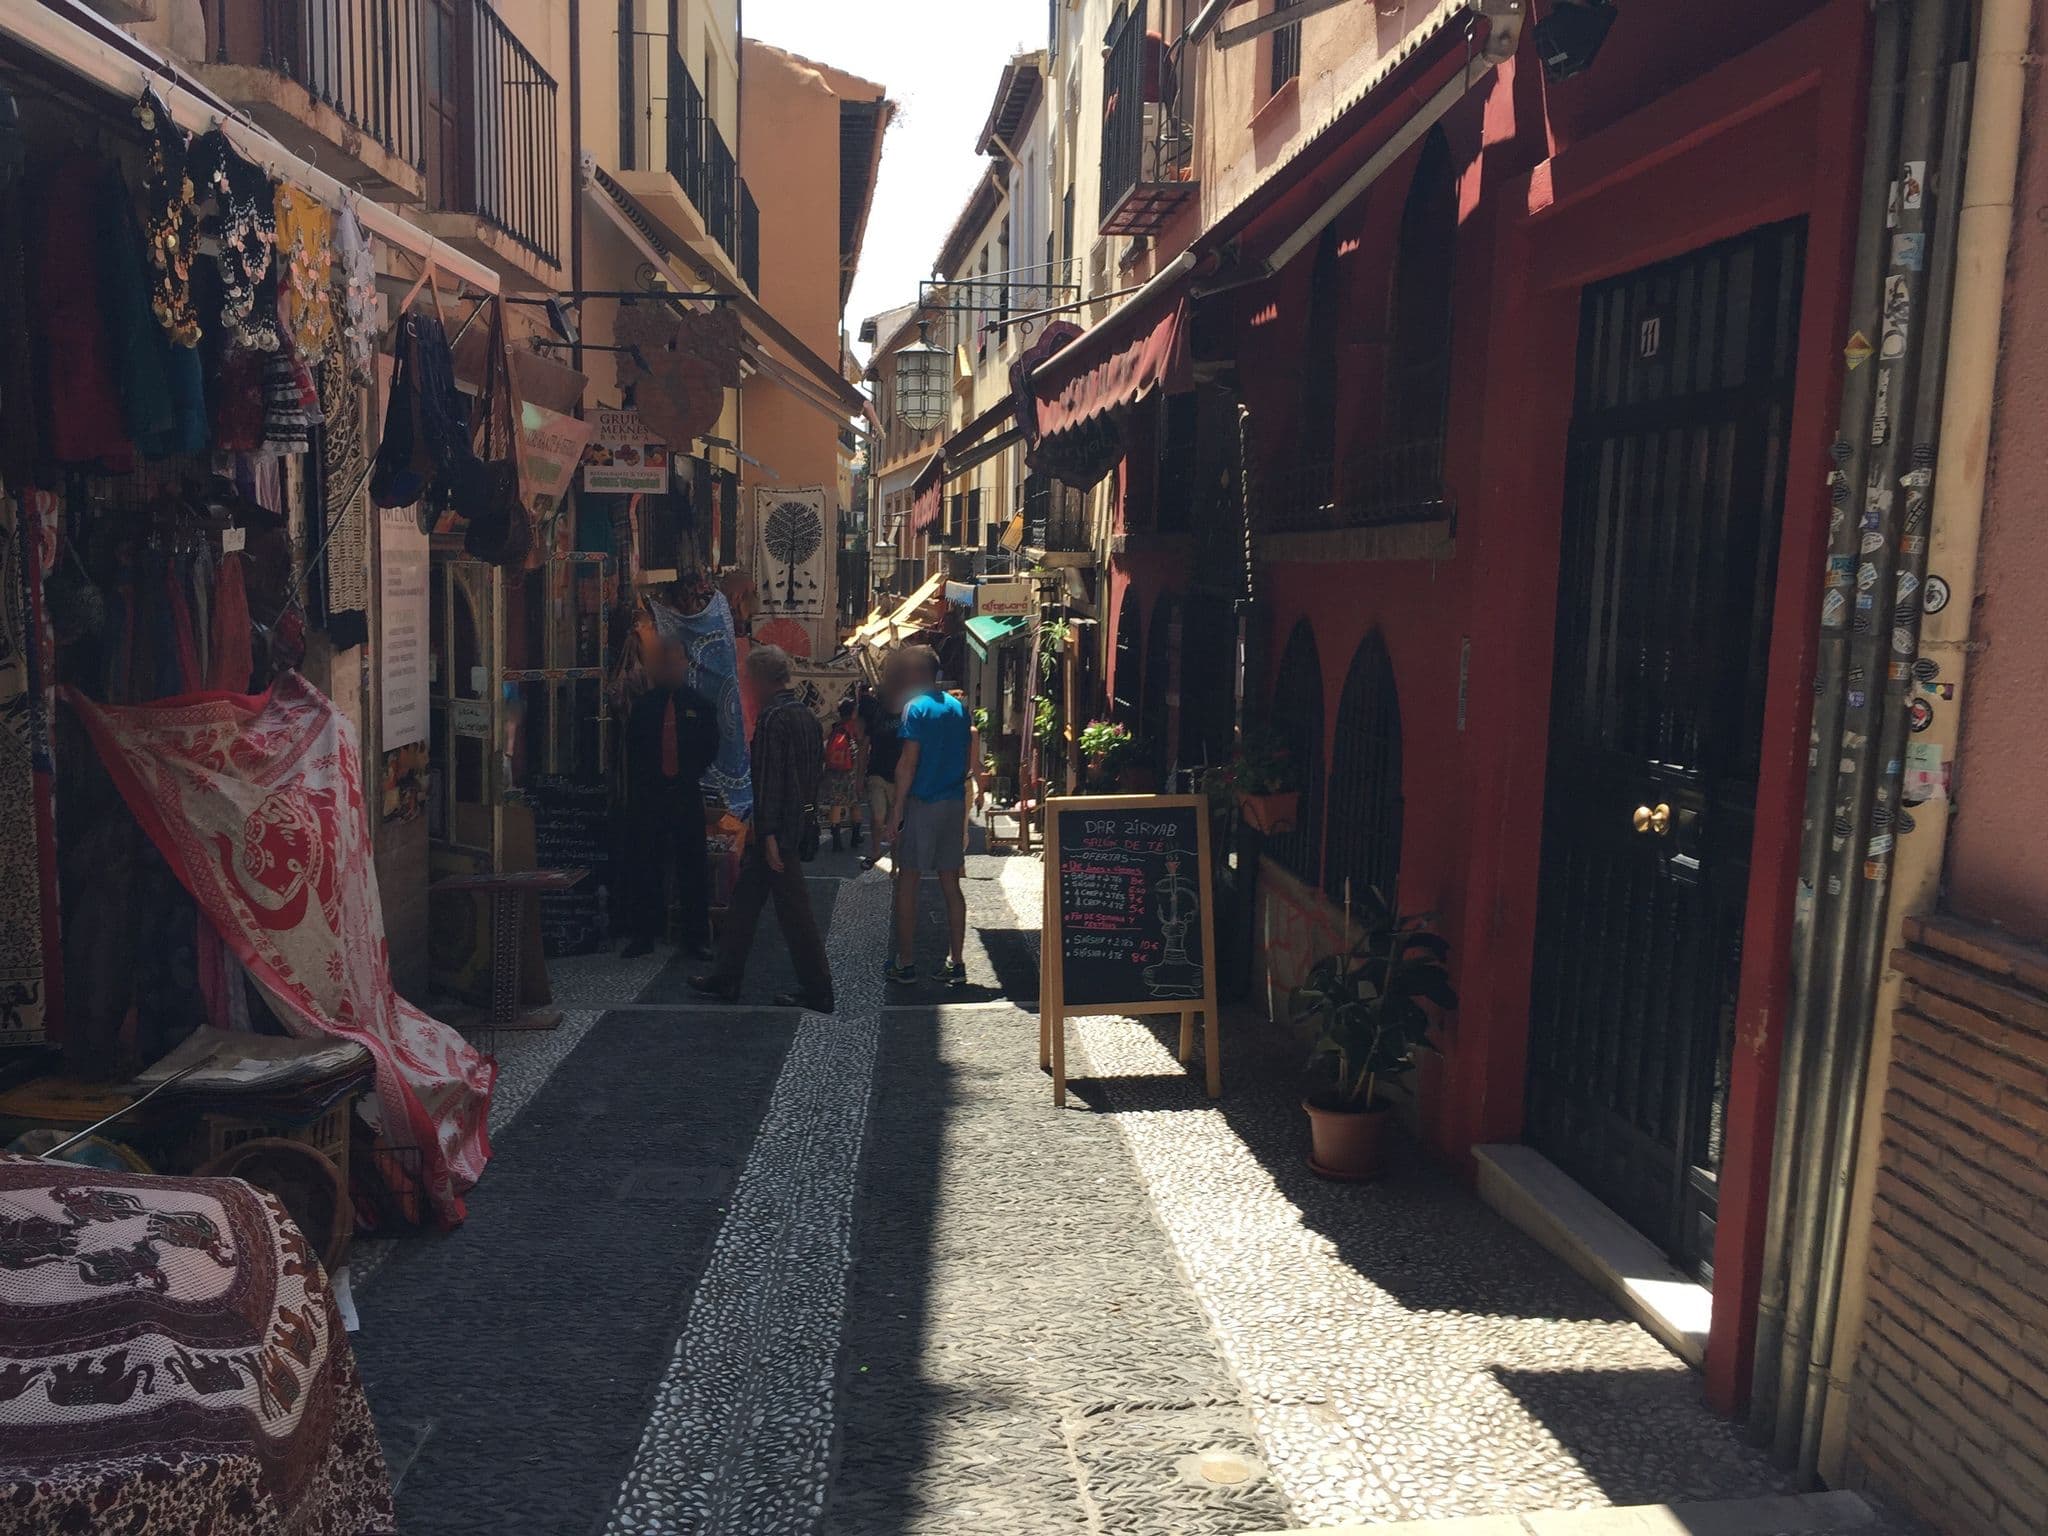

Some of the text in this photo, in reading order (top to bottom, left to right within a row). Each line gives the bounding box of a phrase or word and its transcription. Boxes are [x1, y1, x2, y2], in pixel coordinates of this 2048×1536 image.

[1643, 320, 1656, 354] 11
[601, 425, 649, 434] MEKNES
[1084, 820, 1116, 834] DAR
[1124, 839, 1141, 850] DE
[1082, 852, 1129, 863] OFERTAS
